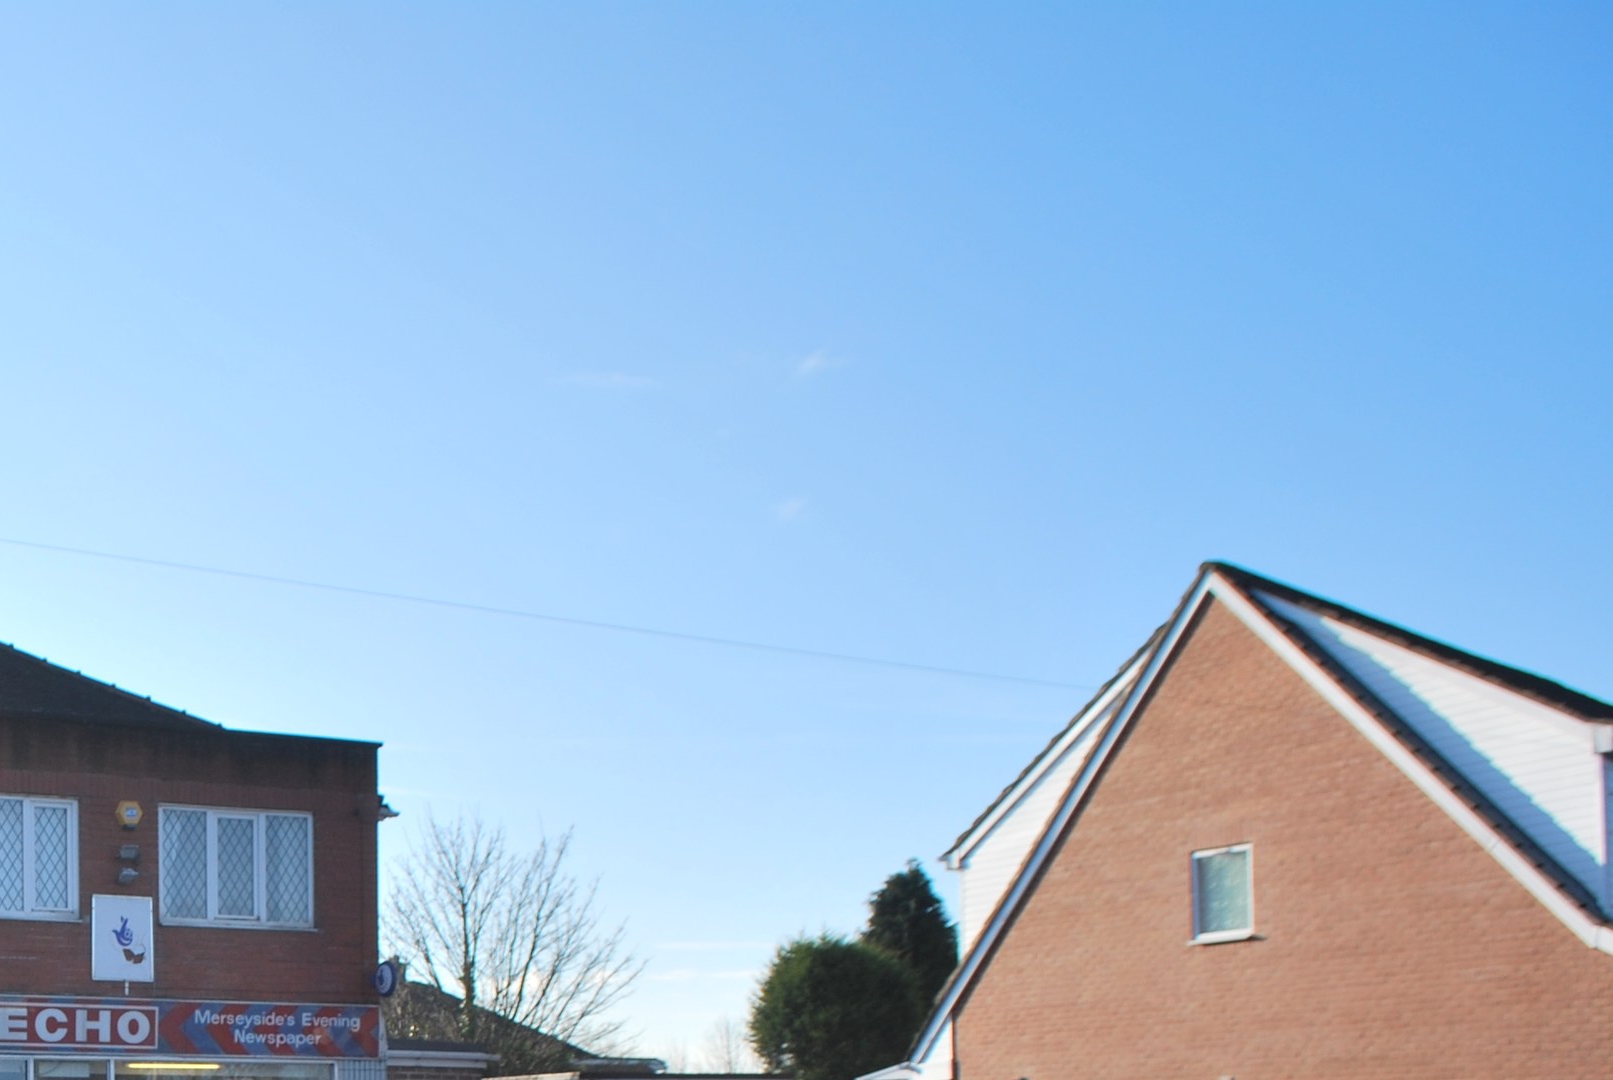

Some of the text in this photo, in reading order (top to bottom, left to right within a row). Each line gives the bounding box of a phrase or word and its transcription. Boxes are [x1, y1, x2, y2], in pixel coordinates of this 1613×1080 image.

[194, 1009, 361, 1031] Merseyside's Evening
[234, 1029, 322, 1048] Newspaper
